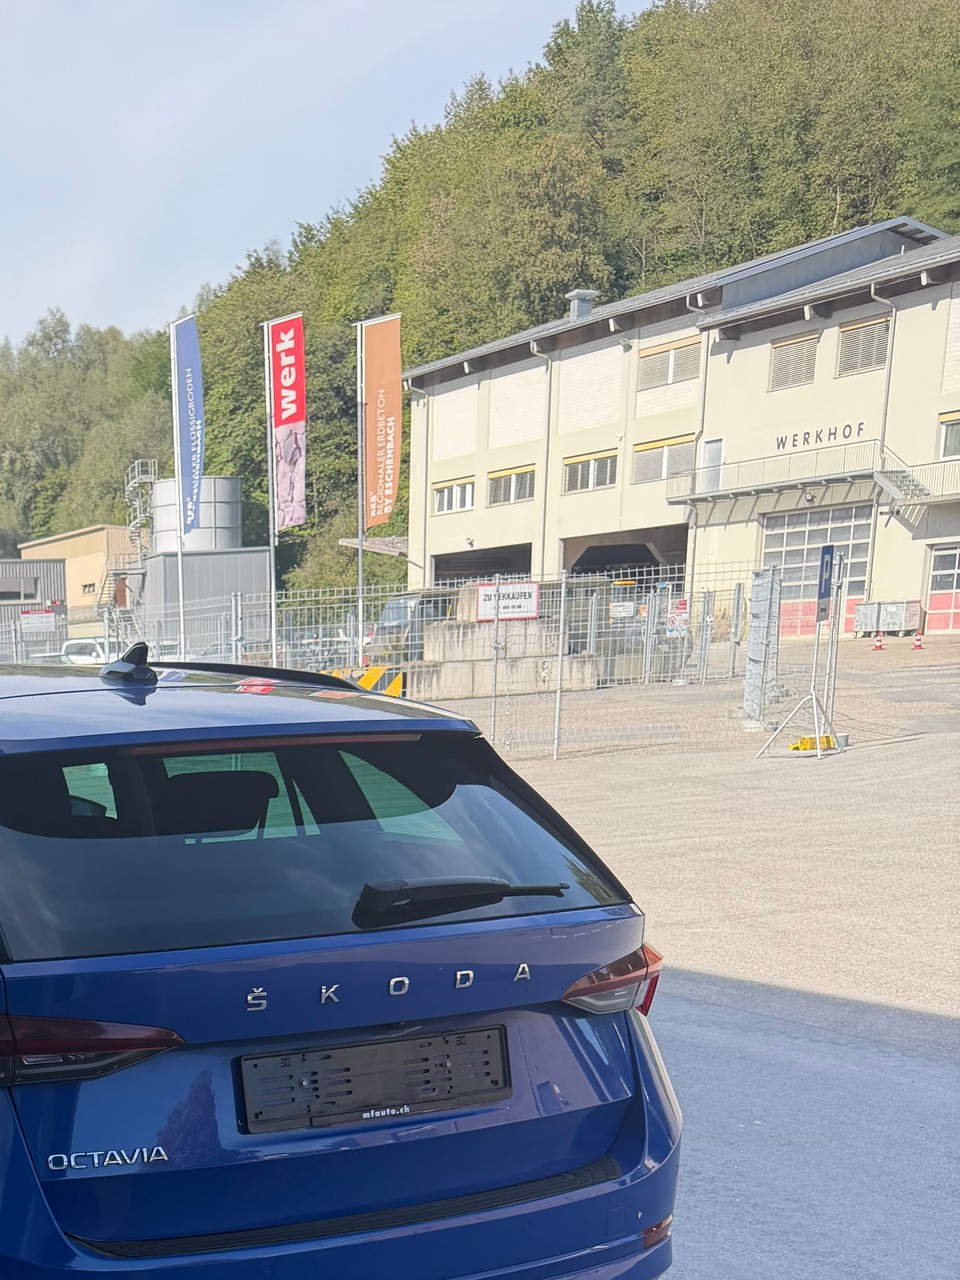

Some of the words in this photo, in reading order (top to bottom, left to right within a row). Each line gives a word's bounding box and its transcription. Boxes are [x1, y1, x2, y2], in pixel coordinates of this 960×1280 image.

[275, 328, 297, 421] werk
[376, 389, 386, 447] ERDBETON
[776, 422, 864, 450] WERKHOF
[384, 416, 395, 495] ESCHENBACH
[376, 449, 386, 515] REGIONALER
[384, 498, 393, 513] BY
[822, 554, 831, 593] P
[246, 963, 531, 1012] ŠKODA
[362, 1105, 410, 1119] mfauto.ch
[47, 1146, 169, 1171] OCTAVIA
